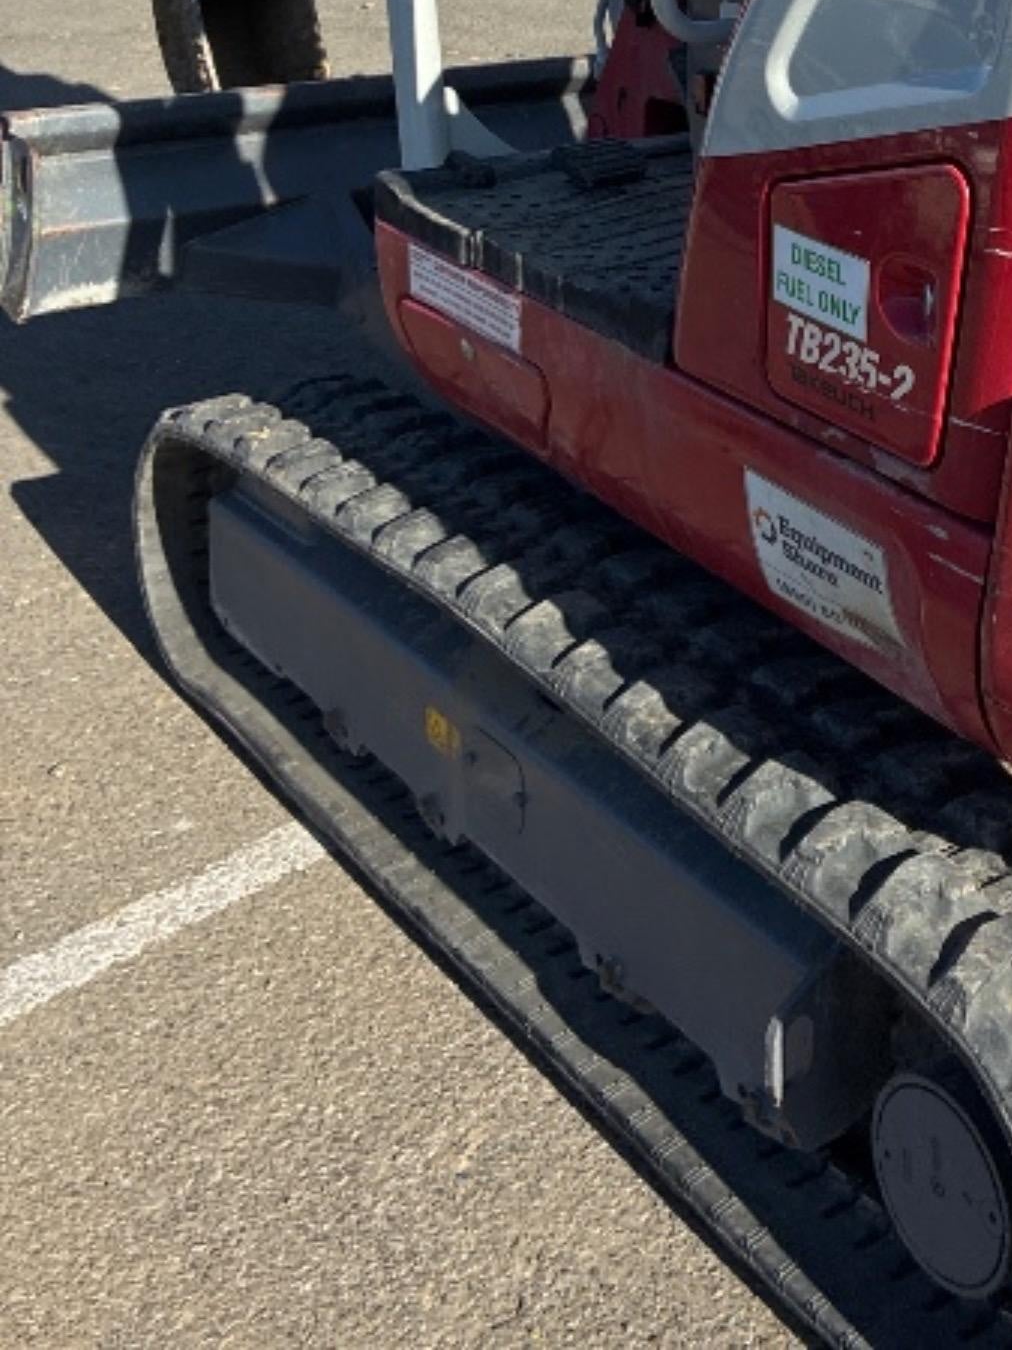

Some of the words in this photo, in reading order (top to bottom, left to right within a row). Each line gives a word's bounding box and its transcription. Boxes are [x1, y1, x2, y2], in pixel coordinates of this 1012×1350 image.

[791, 242, 846, 286] DIESEL
[776, 271, 814, 306] FUEL
[818, 290, 862, 326] ONLY
[786, 312, 916, 401] TB235-2
